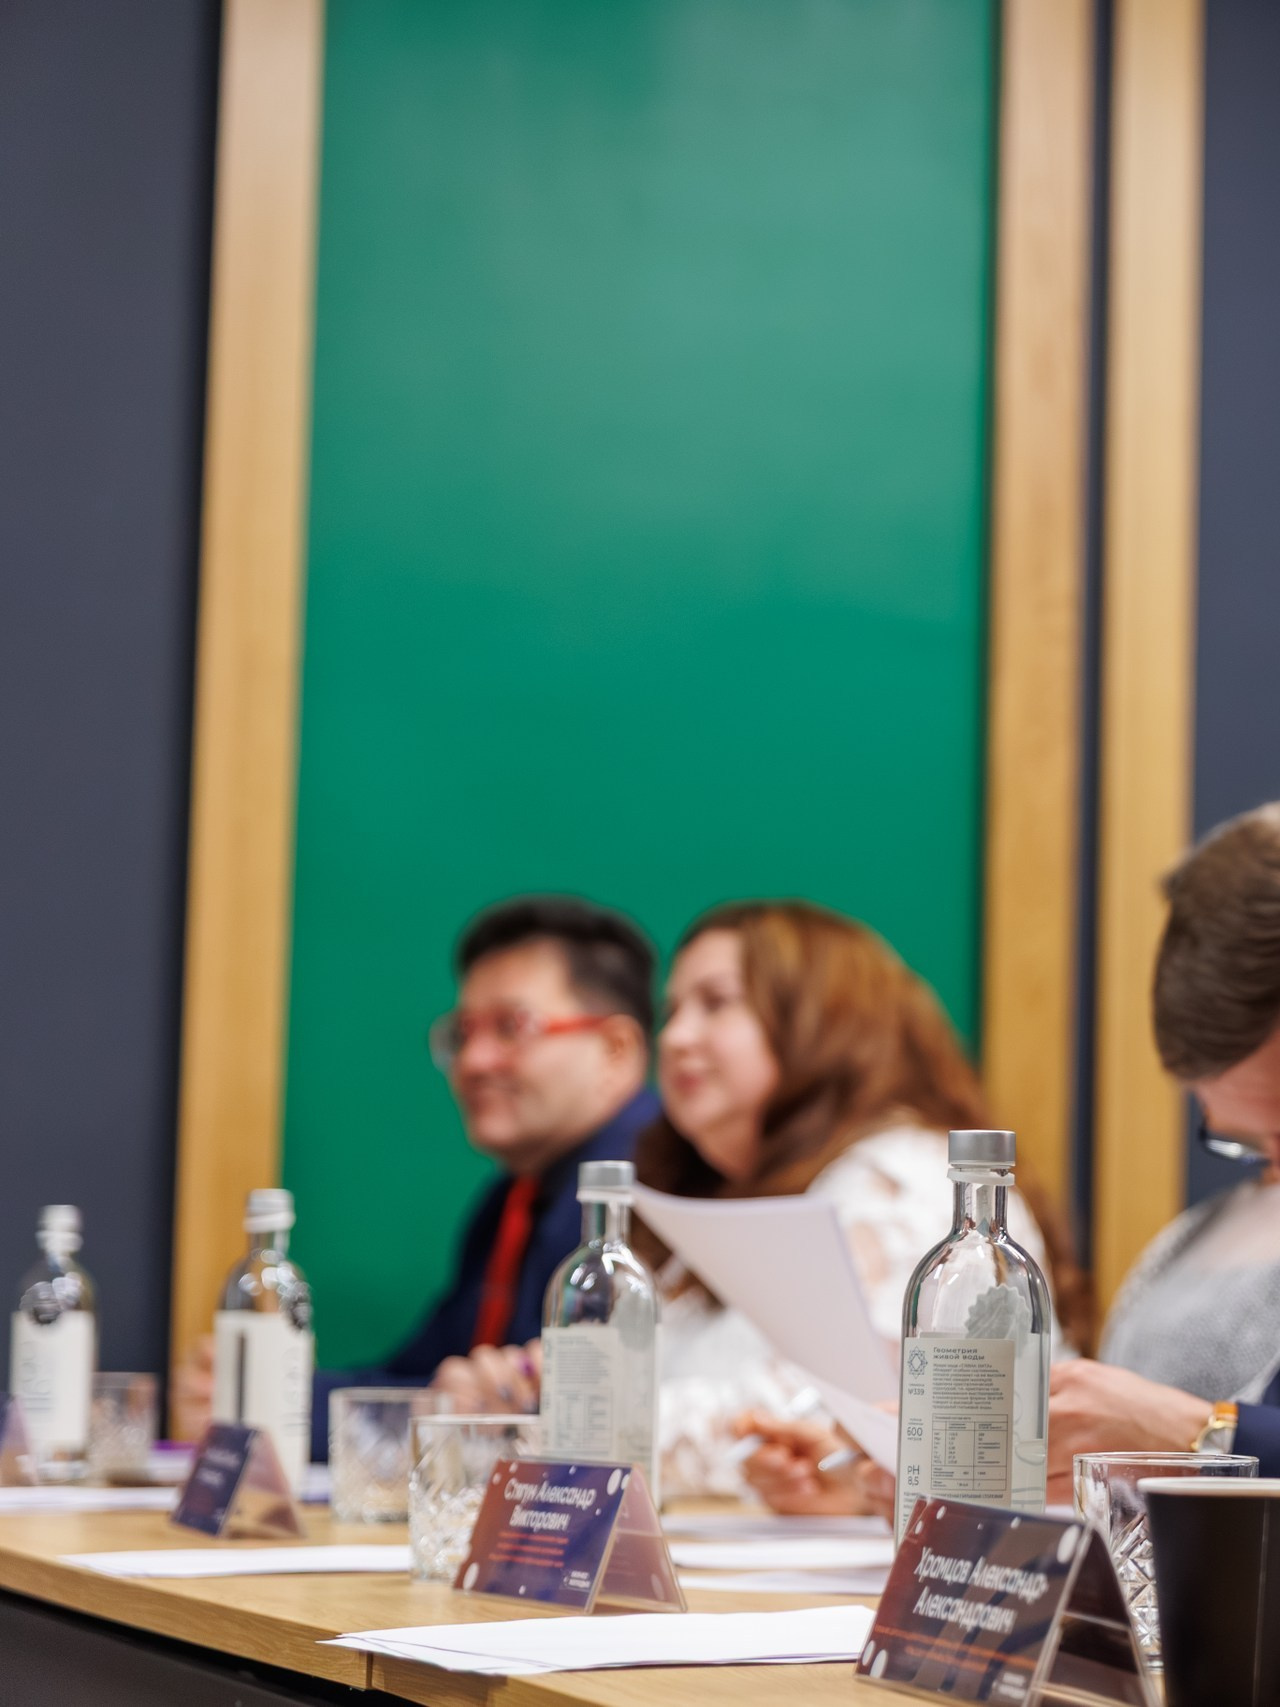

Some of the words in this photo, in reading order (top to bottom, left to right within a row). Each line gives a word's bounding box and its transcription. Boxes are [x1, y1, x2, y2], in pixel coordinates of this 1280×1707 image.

[933, 1346, 977, 1354] Геометрия
[907, 1426, 923, 1437] 600
[908, 1475, 919, 1486] 8,5
[913, 1546, 973, 1585] Храмцов
[967, 1555, 1049, 1605] Александр
[912, 1586, 1018, 1635] Александрович
